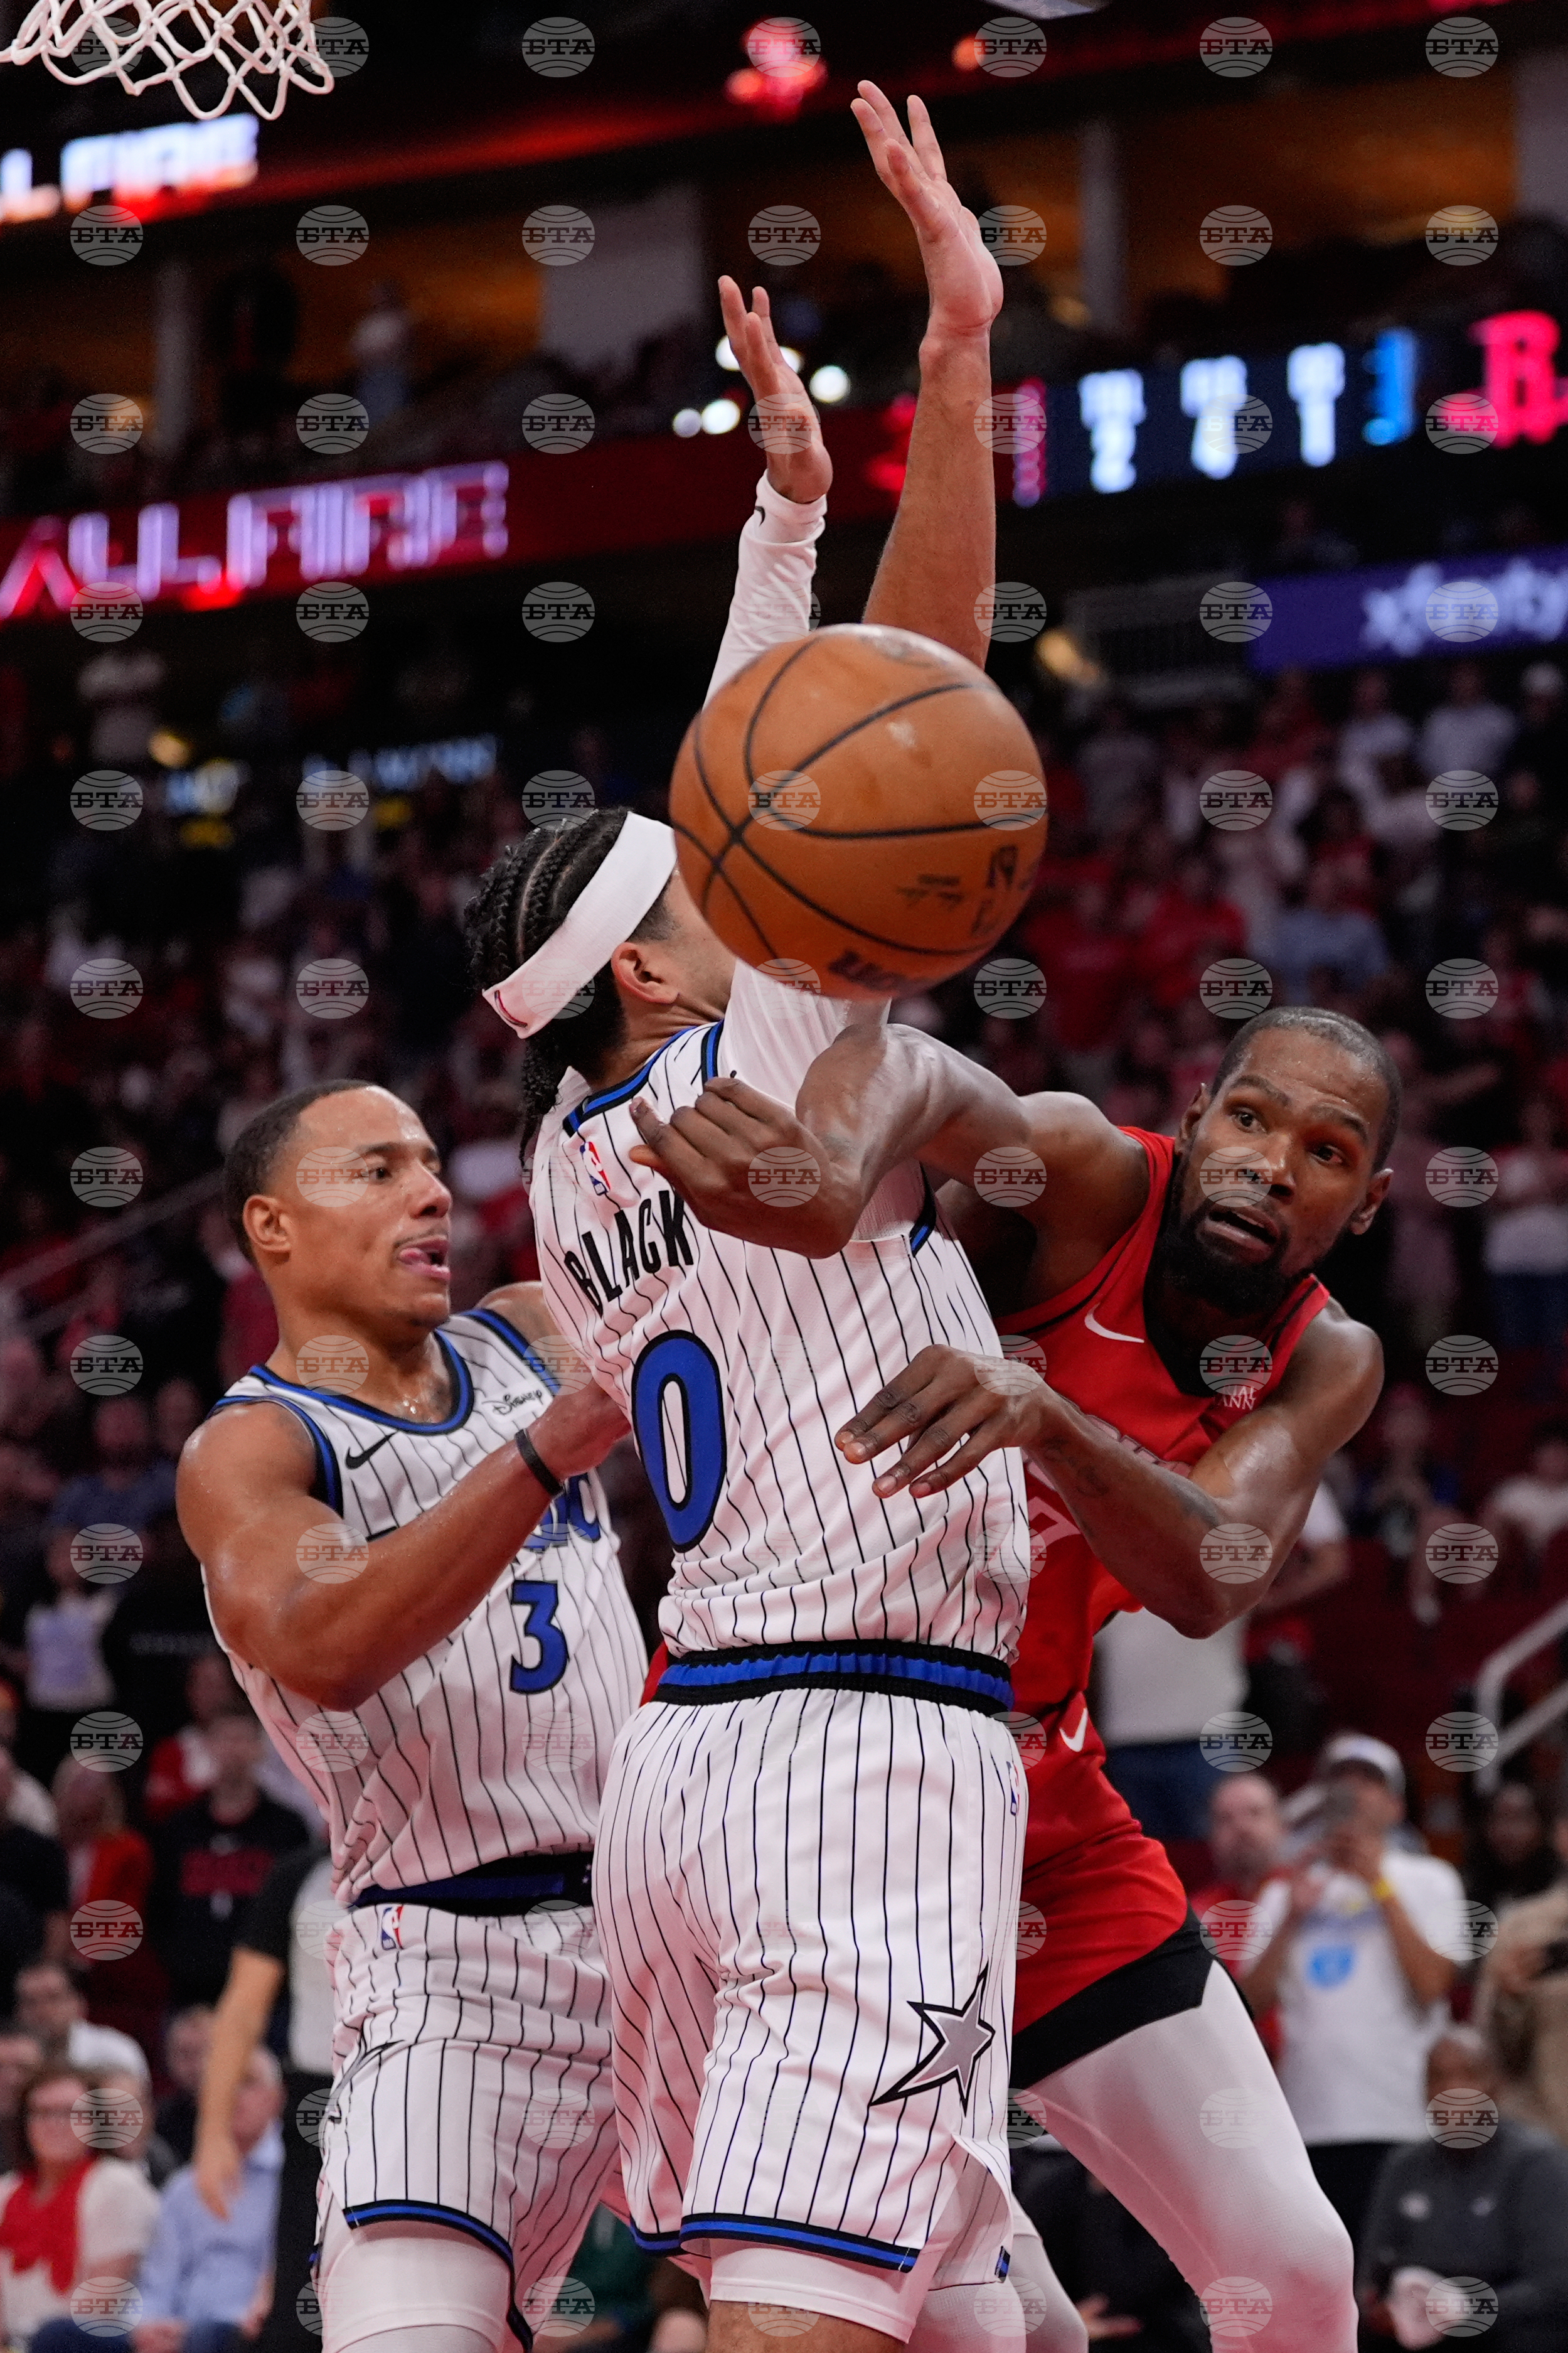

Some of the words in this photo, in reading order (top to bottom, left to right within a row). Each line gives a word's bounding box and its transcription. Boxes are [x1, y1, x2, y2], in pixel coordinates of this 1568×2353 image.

[564, 1190, 693, 1319] BLACK
[631, 1329, 727, 1553] 0
[509, 1580, 570, 1695] 3
